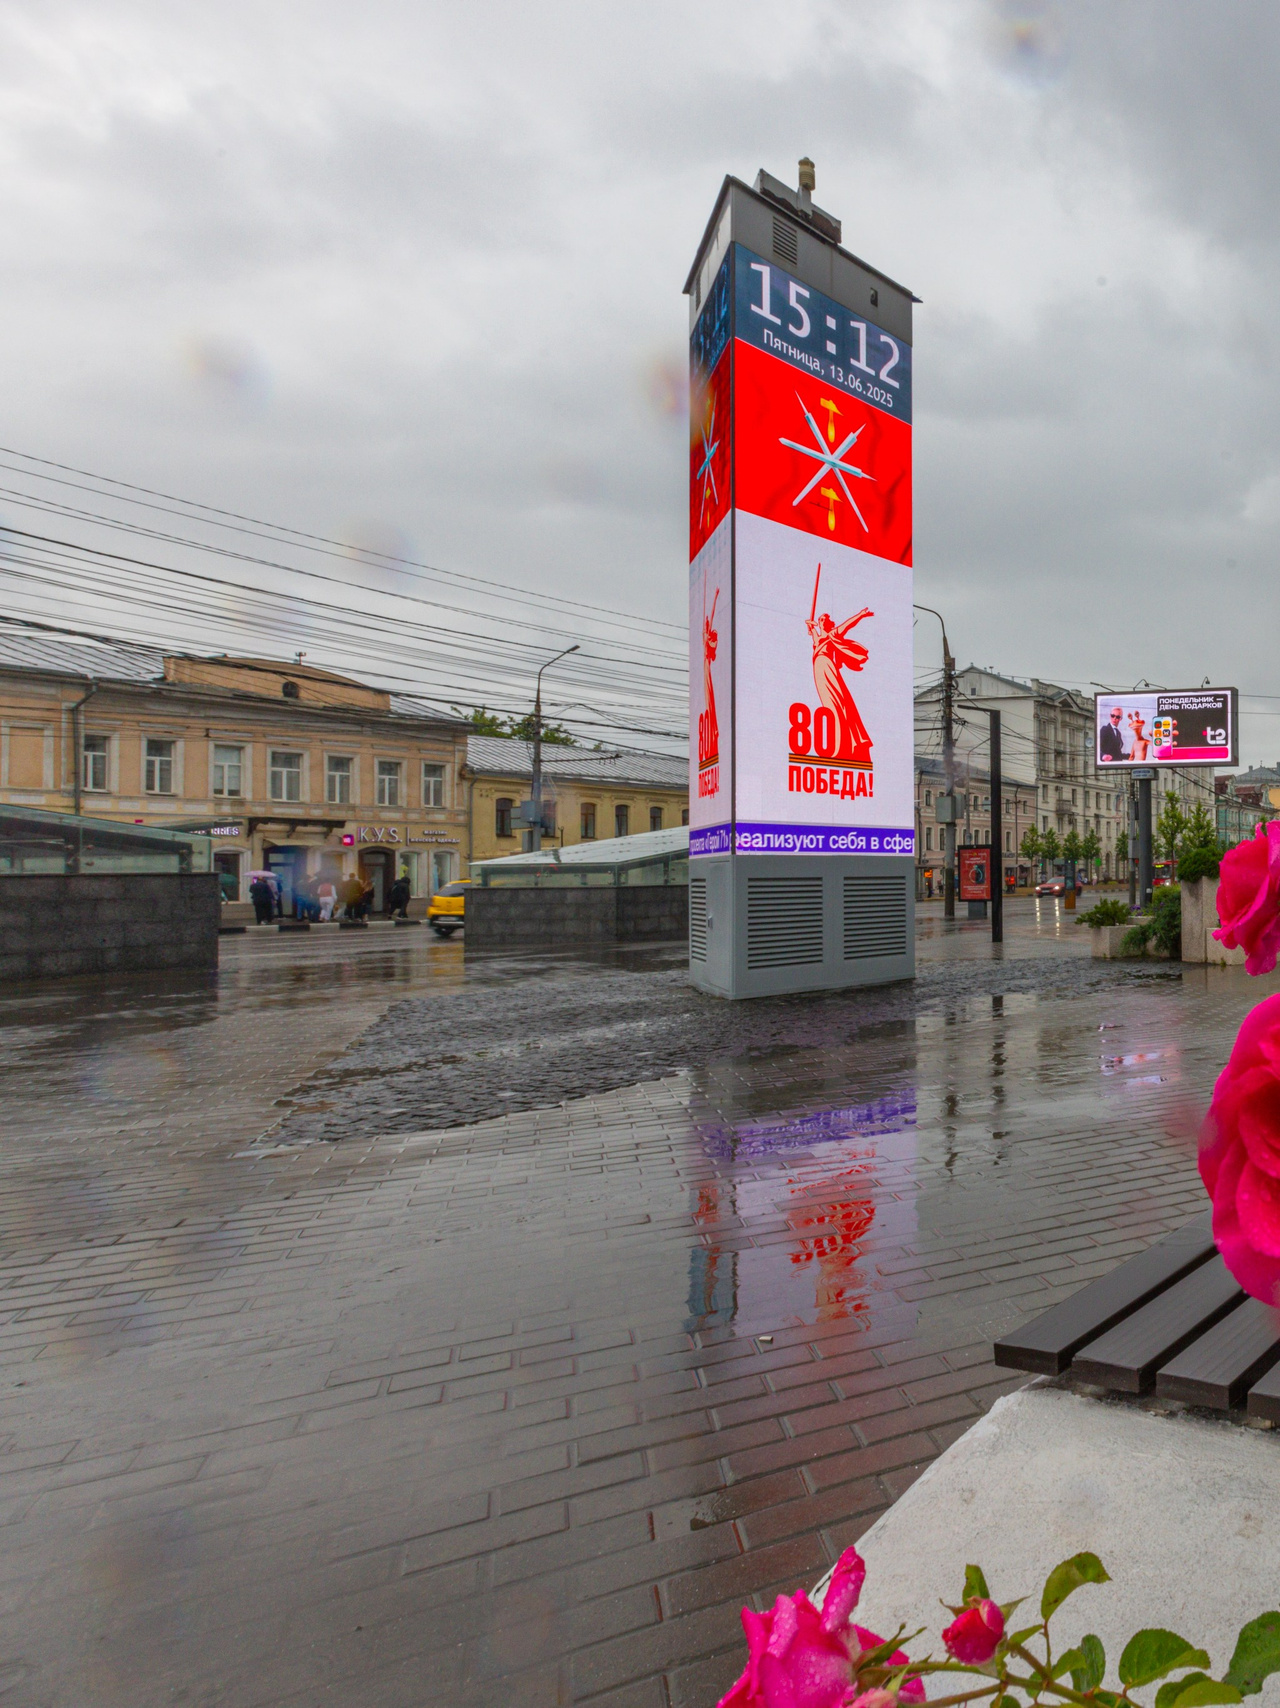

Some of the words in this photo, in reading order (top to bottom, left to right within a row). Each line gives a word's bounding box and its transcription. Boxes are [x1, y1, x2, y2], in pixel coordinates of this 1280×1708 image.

[751, 263, 899, 389] 15:12
[763, 329, 825, 375] Пятница,
[830, 365, 893, 408] 13.06.2025
[698, 709, 711, 762] 80
[788, 702, 836, 757] 80
[1206, 727, 1226, 745] t2
[698, 765, 720, 799] ПОБЕДА!
[788, 765, 873, 800] ПОБЕДА!
[829, 831, 868, 850] себя
[870, 836, 880, 850] в
